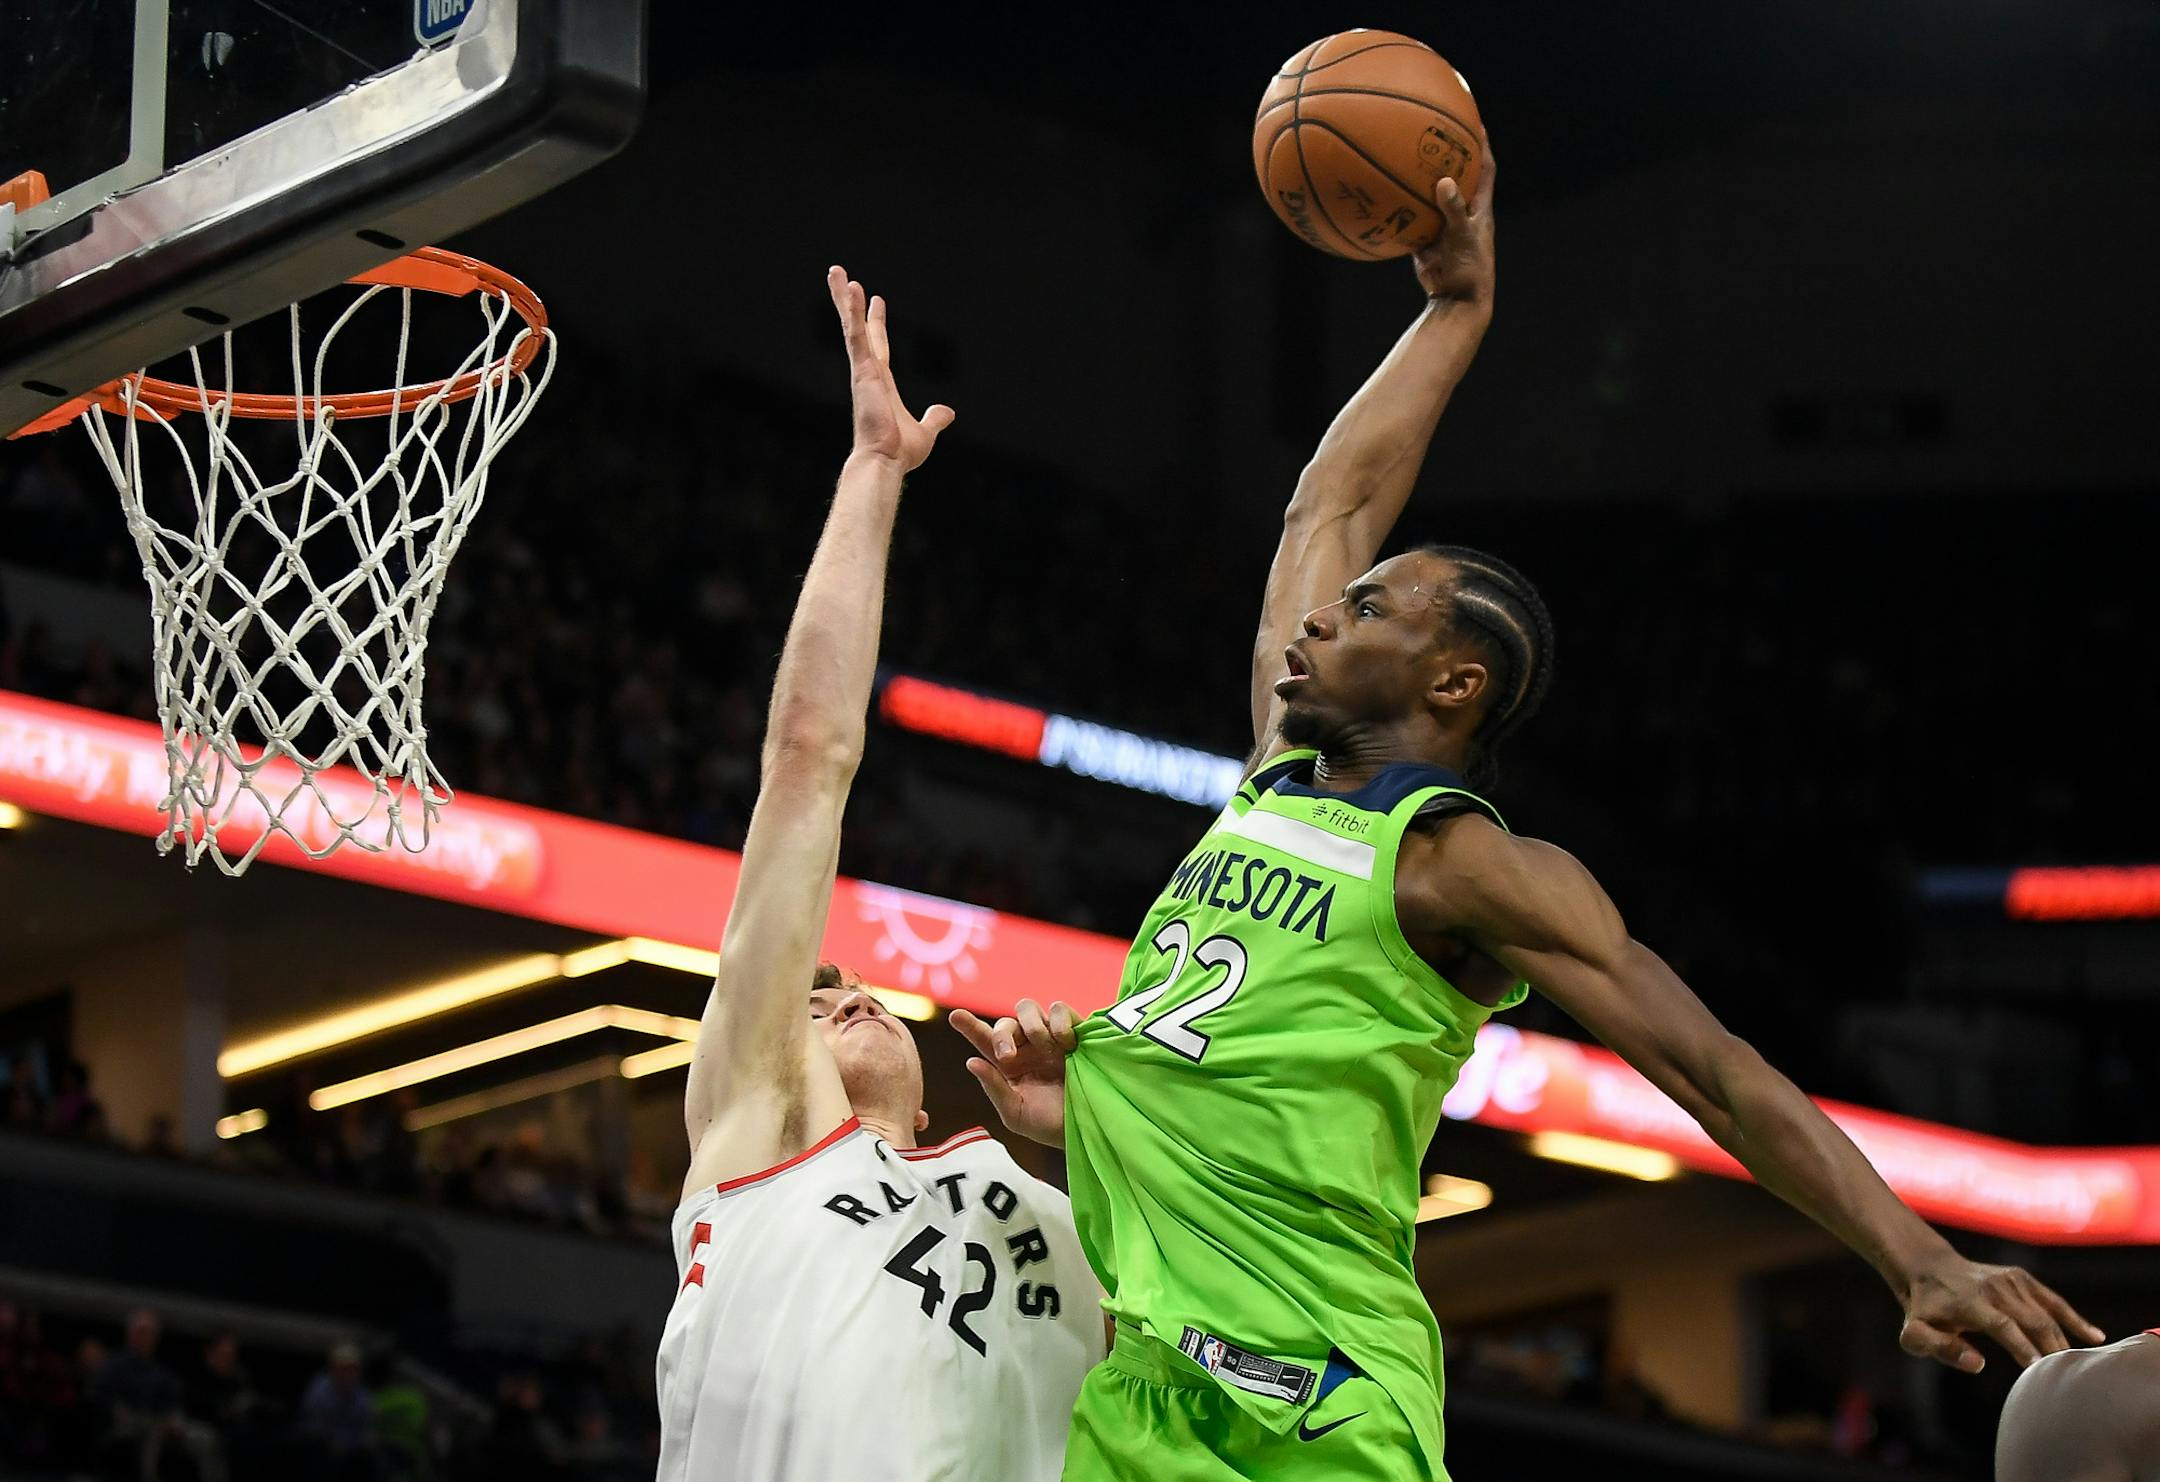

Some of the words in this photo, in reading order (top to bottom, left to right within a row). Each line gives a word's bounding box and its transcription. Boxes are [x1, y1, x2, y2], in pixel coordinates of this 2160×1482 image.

[1329, 809, 1370, 834] fitbit
[1106, 918, 1248, 1065] 22
[824, 1171, 1061, 1320] RATORS
[883, 1224, 997, 1359] 42
